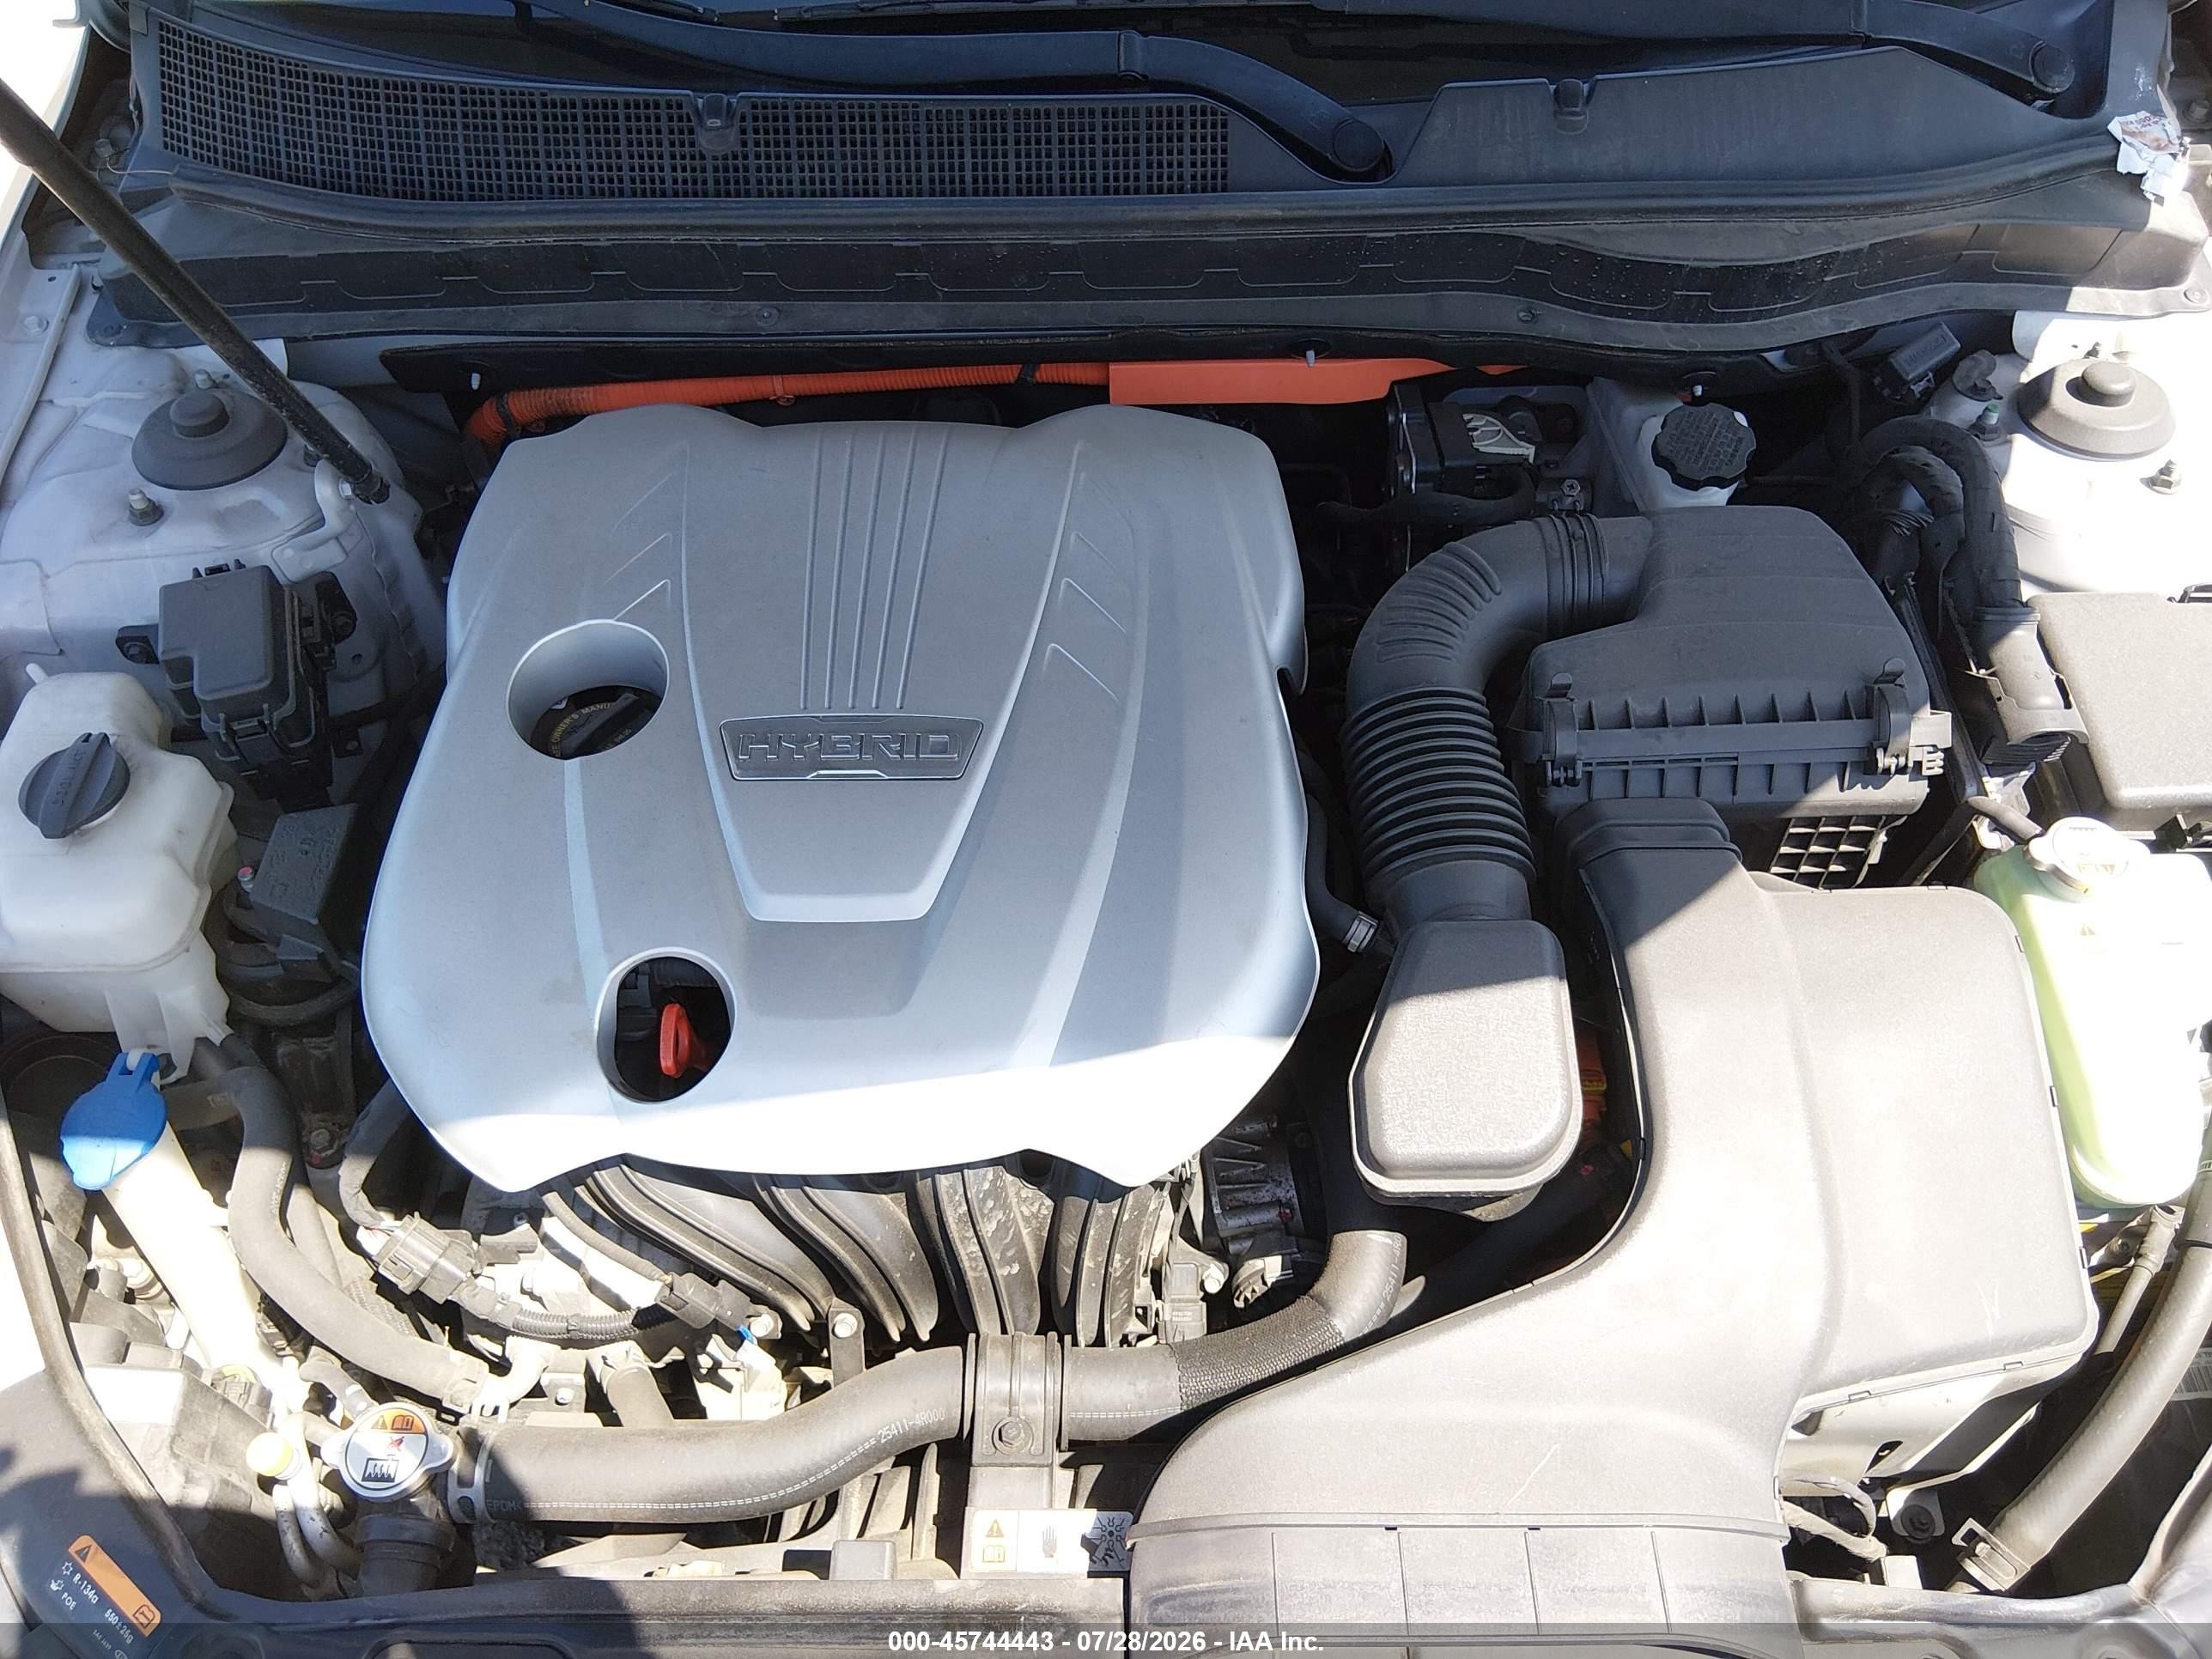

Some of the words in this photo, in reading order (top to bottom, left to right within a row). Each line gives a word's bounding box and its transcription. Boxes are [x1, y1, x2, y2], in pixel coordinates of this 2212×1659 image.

[550, 713, 580, 743] OWNER'S
[580, 702, 612, 715] MANU
[738, 732, 961, 762] HYBRID
[877, 1407, 945, 1443] 25411-4R000
[61, 1592, 77, 1611] POE
[72, 1572, 99, 1604] R-134a
